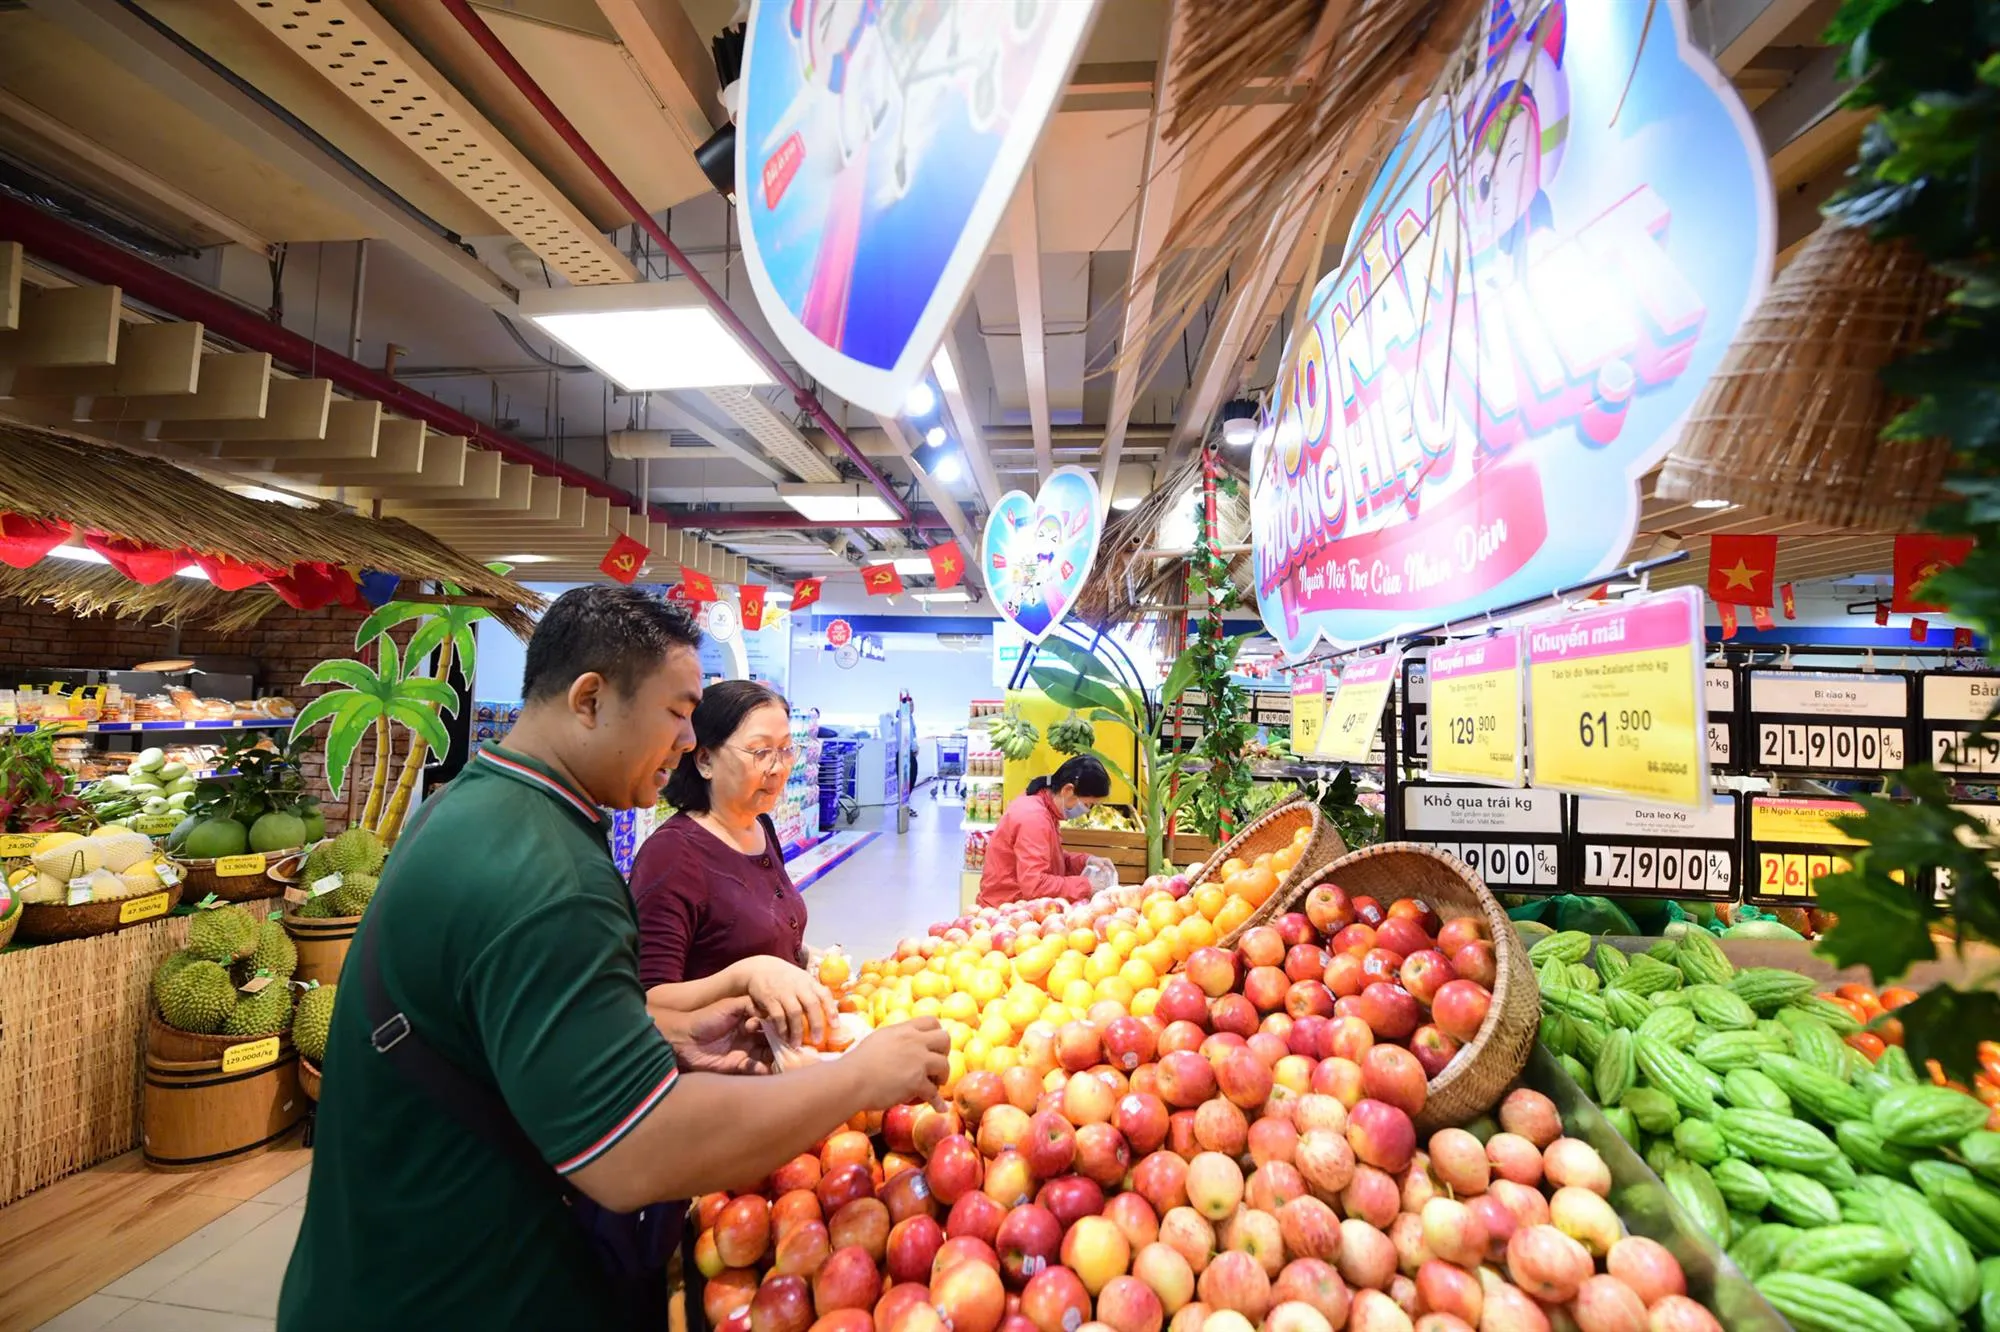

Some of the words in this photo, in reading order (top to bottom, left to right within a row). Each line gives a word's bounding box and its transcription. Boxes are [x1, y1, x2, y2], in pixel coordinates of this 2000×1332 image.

[1299, 565, 1325, 599] Người
[1326, 558, 1346, 594] Nội
[1347, 557, 1368, 597] Trợ
[1371, 559, 1401, 595] Của
[1404, 553, 1453, 593] Nhân
[1456, 518, 1507, 573] Dân
[1532, 622, 1589, 656] Khuyến
[1591, 617, 1626, 643] mãi
[1432, 650, 1464, 674] Khuyến
[1465, 647, 1486, 668] mãi
[1584, 667, 1600, 676] New
[1601, 664, 1635, 675] Zealand
[1656, 661, 1669, 673] kg
[1715, 678, 1729, 689] kg
[1845, 690, 1857, 701] kg
[1301, 719, 1310, 736] 79
[1341, 713, 1357, 733] 49
[1449, 716, 1475, 745] 129
[1579, 711, 1609, 748] 61
[1764, 729, 1876, 760] 21.900
[1423, 792, 1452, 807] Khổ
[1456, 798, 1483, 812] qua
[1487, 795, 1510, 808] trái
[1515, 796, 1533, 812] kg
[1793, 807, 1817, 816] Xanh
[1635, 810, 1655, 819] Dưa
[1657, 811, 1672, 819] leo
[1673, 812, 1687, 821] Kg
[1593, 850, 1703, 881] 17.900
